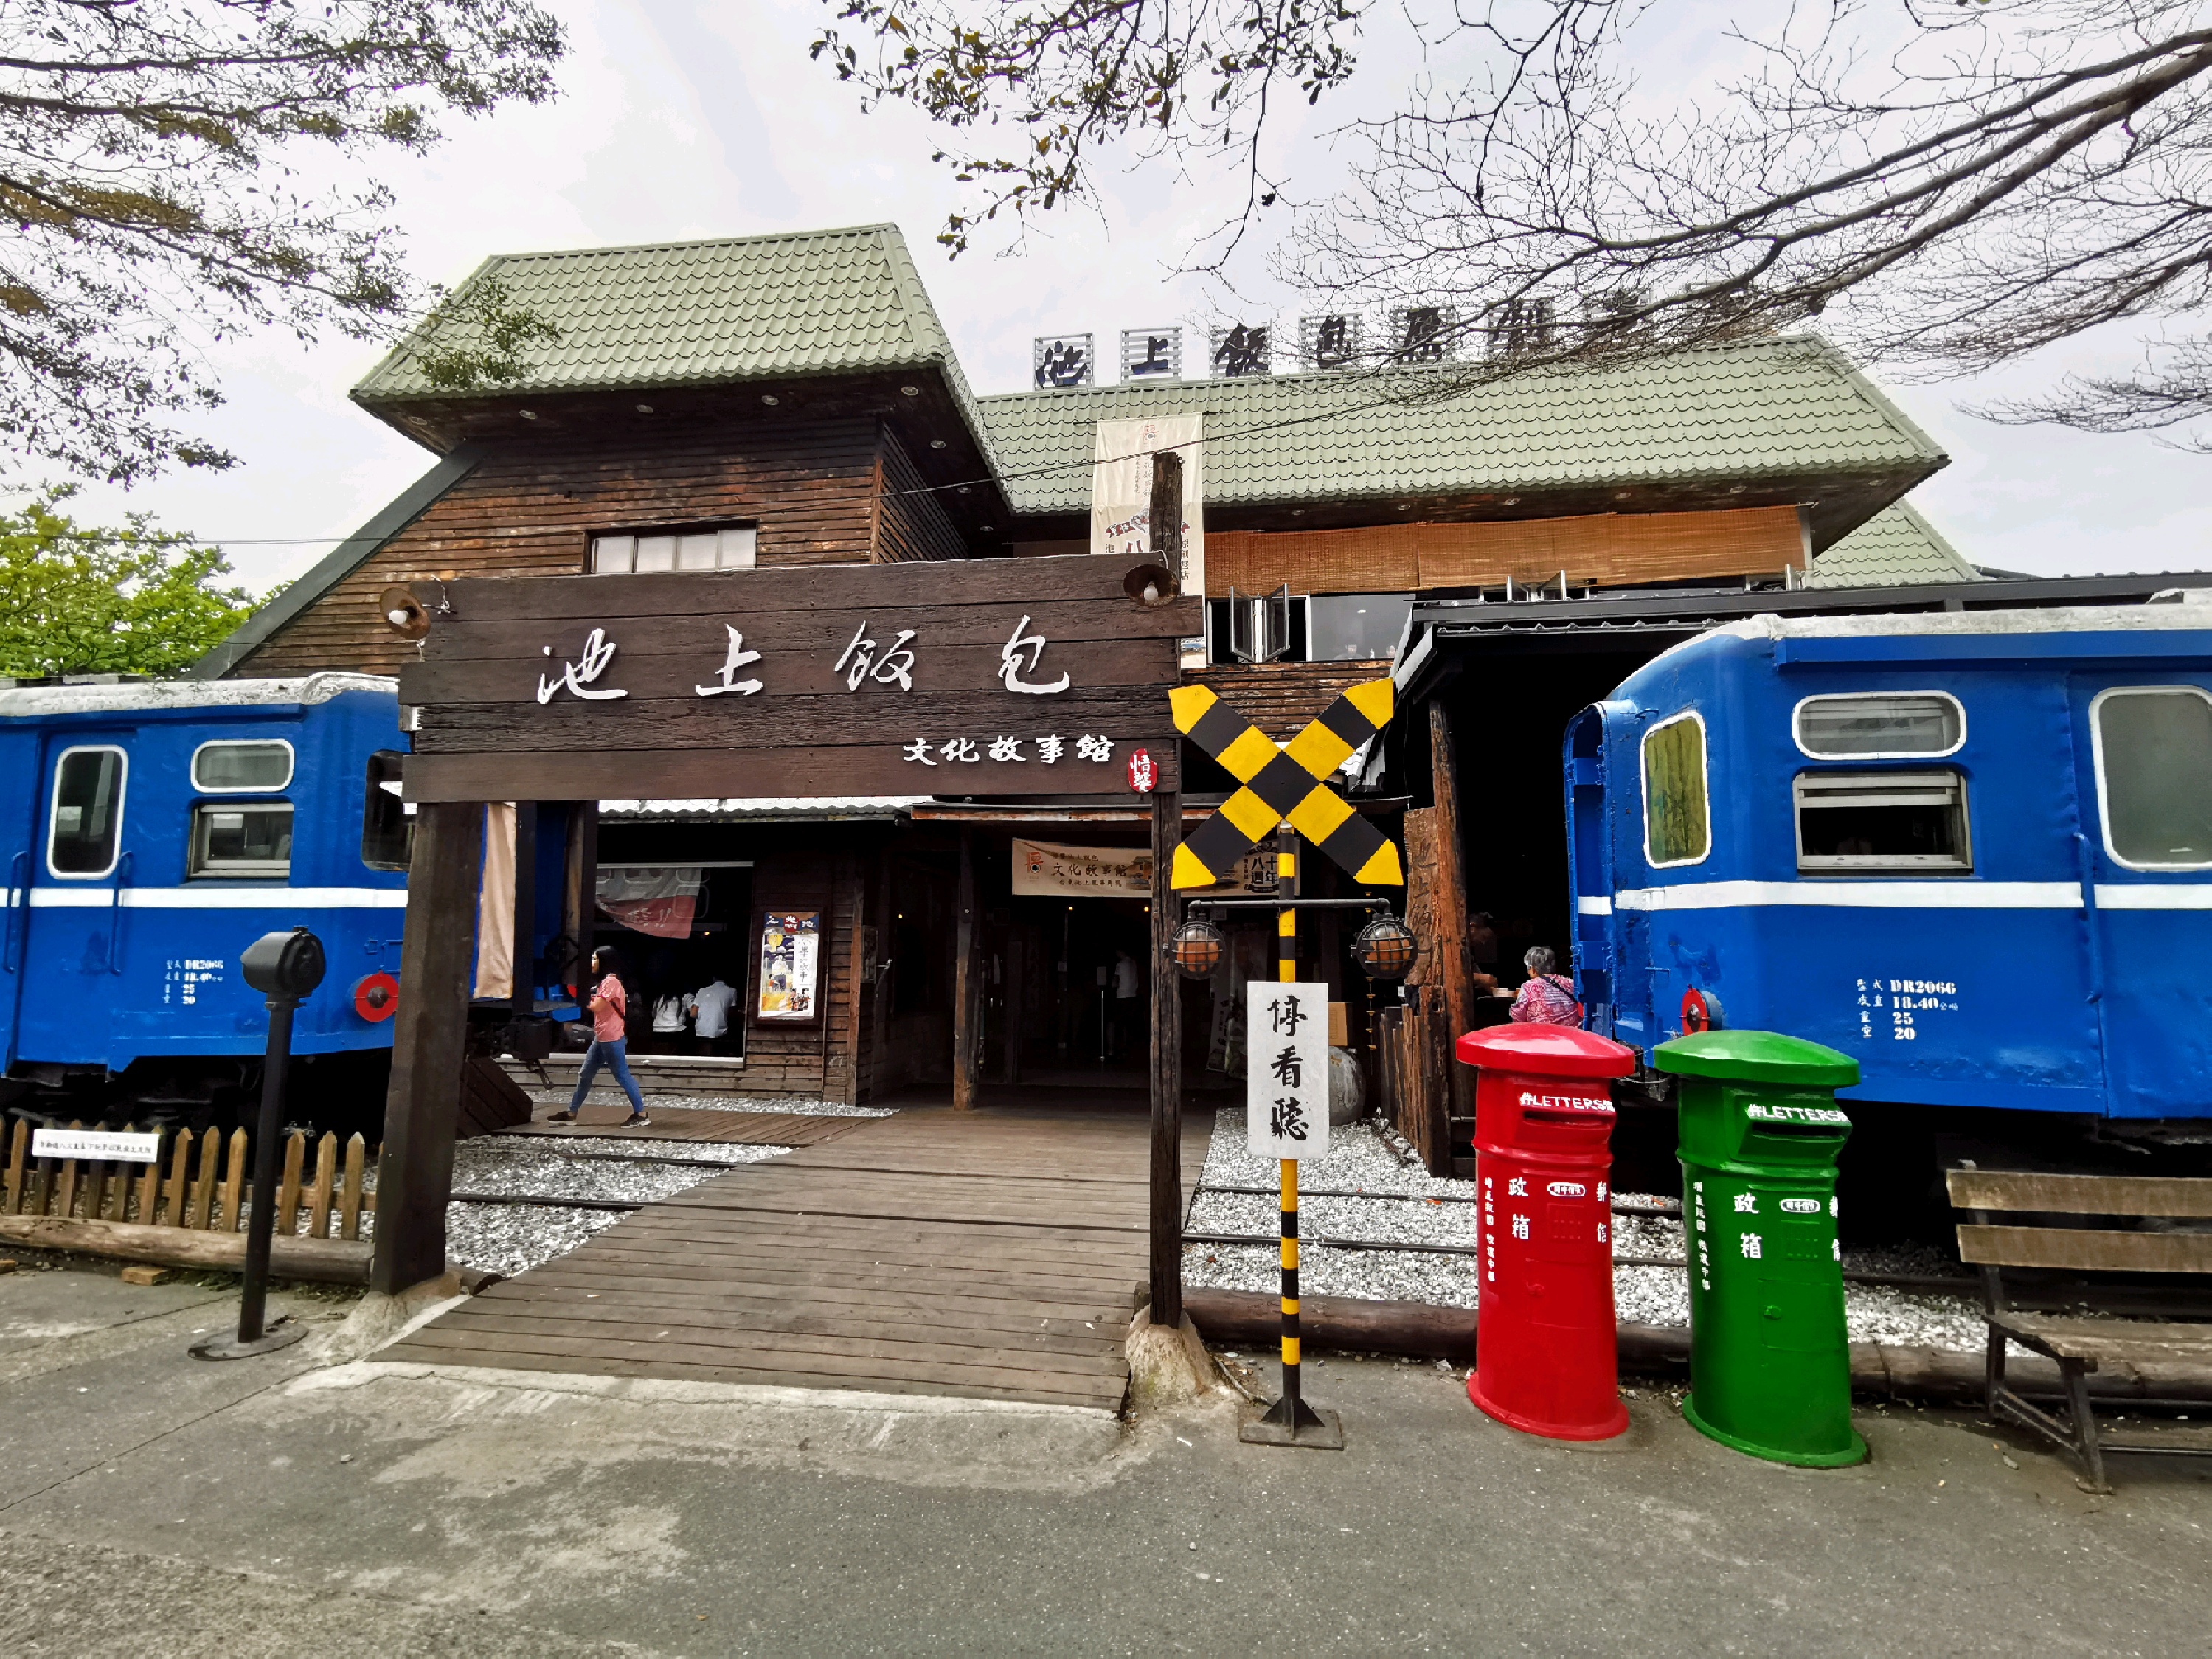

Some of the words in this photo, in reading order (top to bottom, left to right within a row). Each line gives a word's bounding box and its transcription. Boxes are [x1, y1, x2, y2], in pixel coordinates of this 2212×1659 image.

[538, 614, 1070, 705] 池上飯包
[902, 733, 1115, 766] 文化故事館
[1051, 863, 1127, 876] 文化故事館
[1890, 979, 1957, 994] DR2066
[1893, 1011, 1913, 1025] 25
[1894, 1027, 1916, 1040] 20
[1267, 995, 1309, 1140] 停看聽
